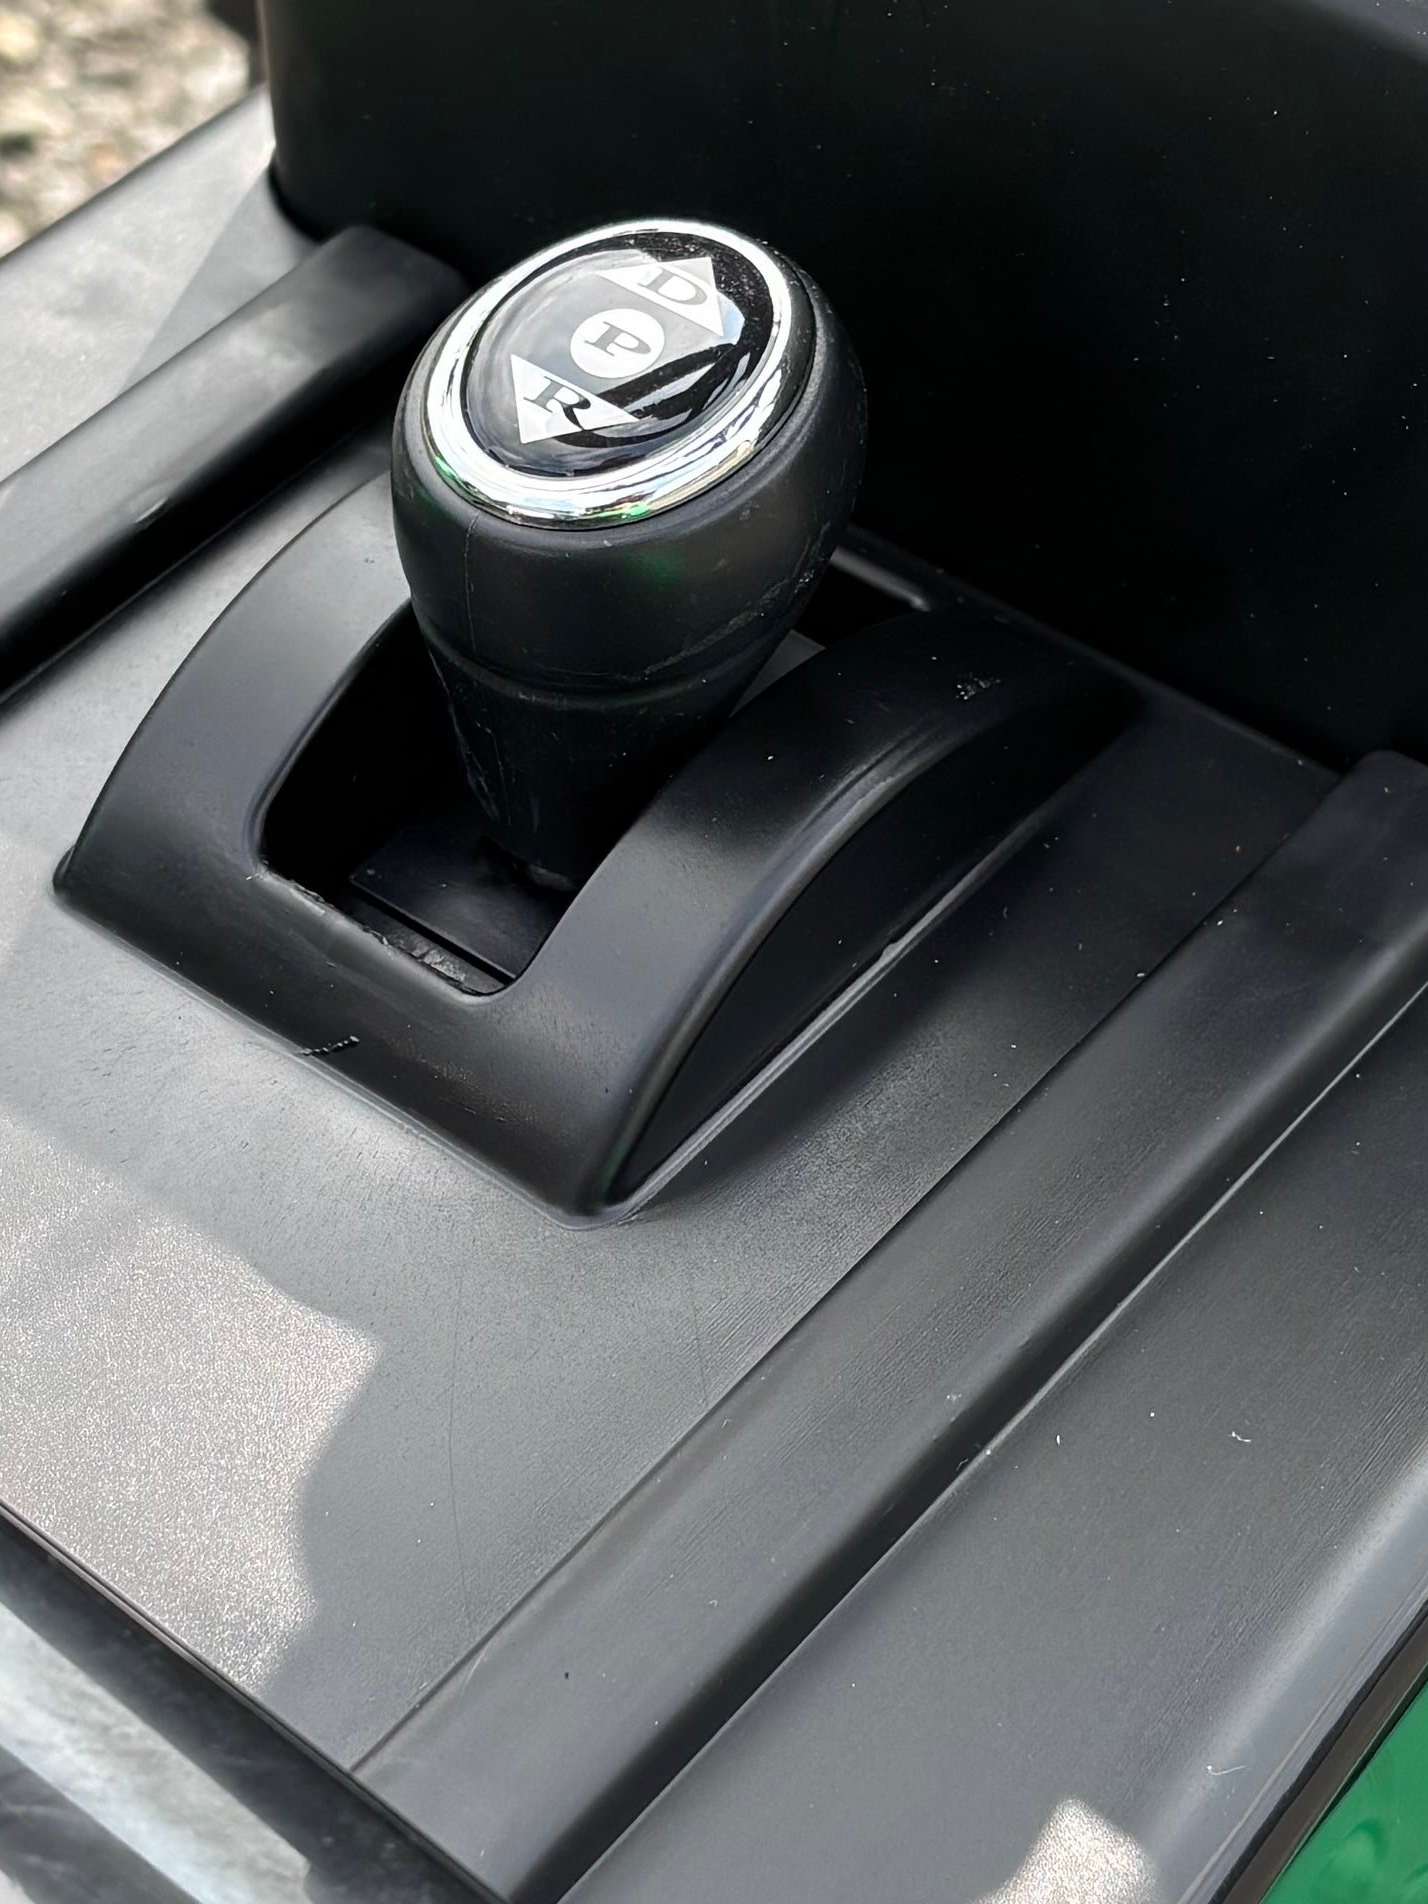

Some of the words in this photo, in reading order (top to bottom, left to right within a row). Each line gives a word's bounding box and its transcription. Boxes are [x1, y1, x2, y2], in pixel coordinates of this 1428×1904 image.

[638, 266, 708, 305] D
[584, 320, 651, 357] P
[523, 375, 592, 431] R
